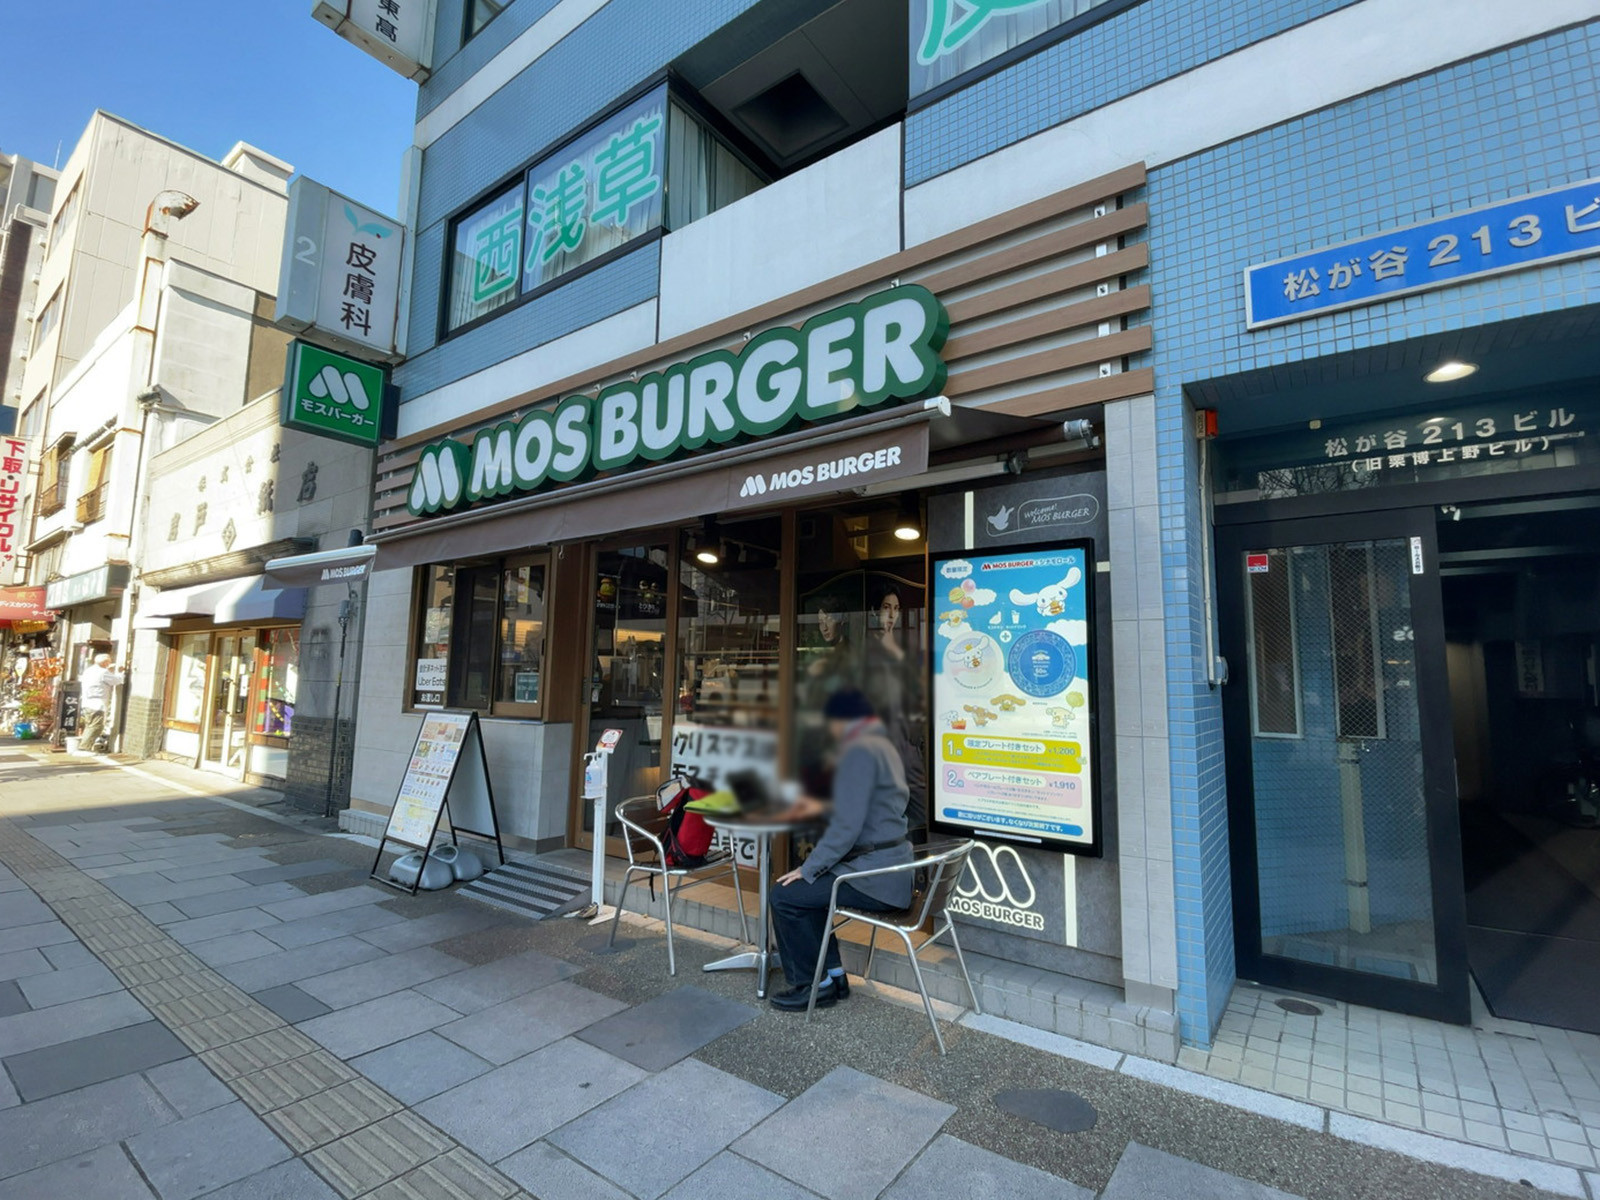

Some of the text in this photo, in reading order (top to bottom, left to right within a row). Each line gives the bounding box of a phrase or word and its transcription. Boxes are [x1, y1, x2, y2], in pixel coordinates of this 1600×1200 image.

[471, 113, 663, 304] 西浅草
[340, 241, 377, 337] 皮膚科
[301, 398, 375, 427] モスバーガー
[471, 298, 926, 494] MOS BURGER
[769, 446, 902, 491] MOS BURGER
[1052, 507, 1090, 521] BURGER
[1007, 560, 1034, 568] BURGER
[948, 896, 1044, 931] MOS BURGER
